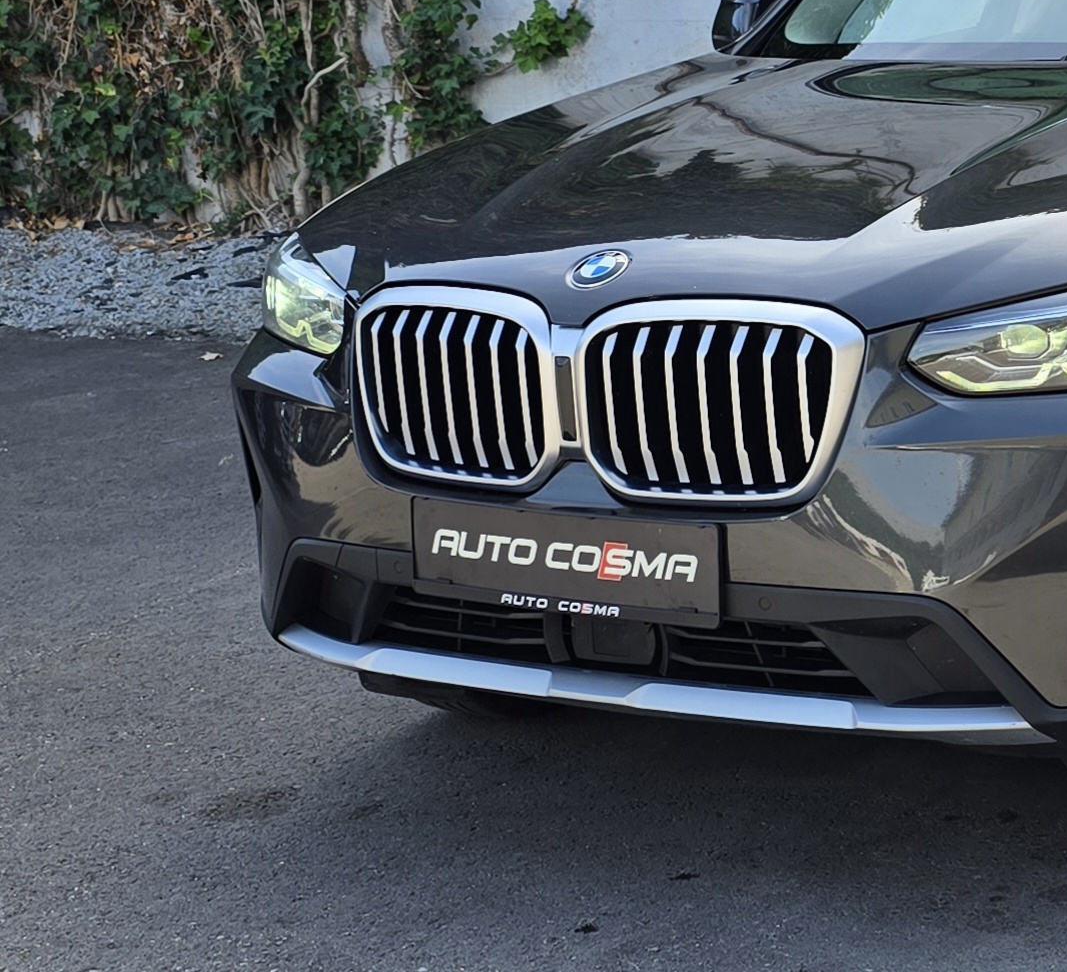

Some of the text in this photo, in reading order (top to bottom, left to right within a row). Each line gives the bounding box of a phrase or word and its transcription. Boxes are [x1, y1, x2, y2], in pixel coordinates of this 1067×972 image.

[431, 528, 698, 582] AUTO COSMA
[500, 593, 620, 617] AUTO COSMA
